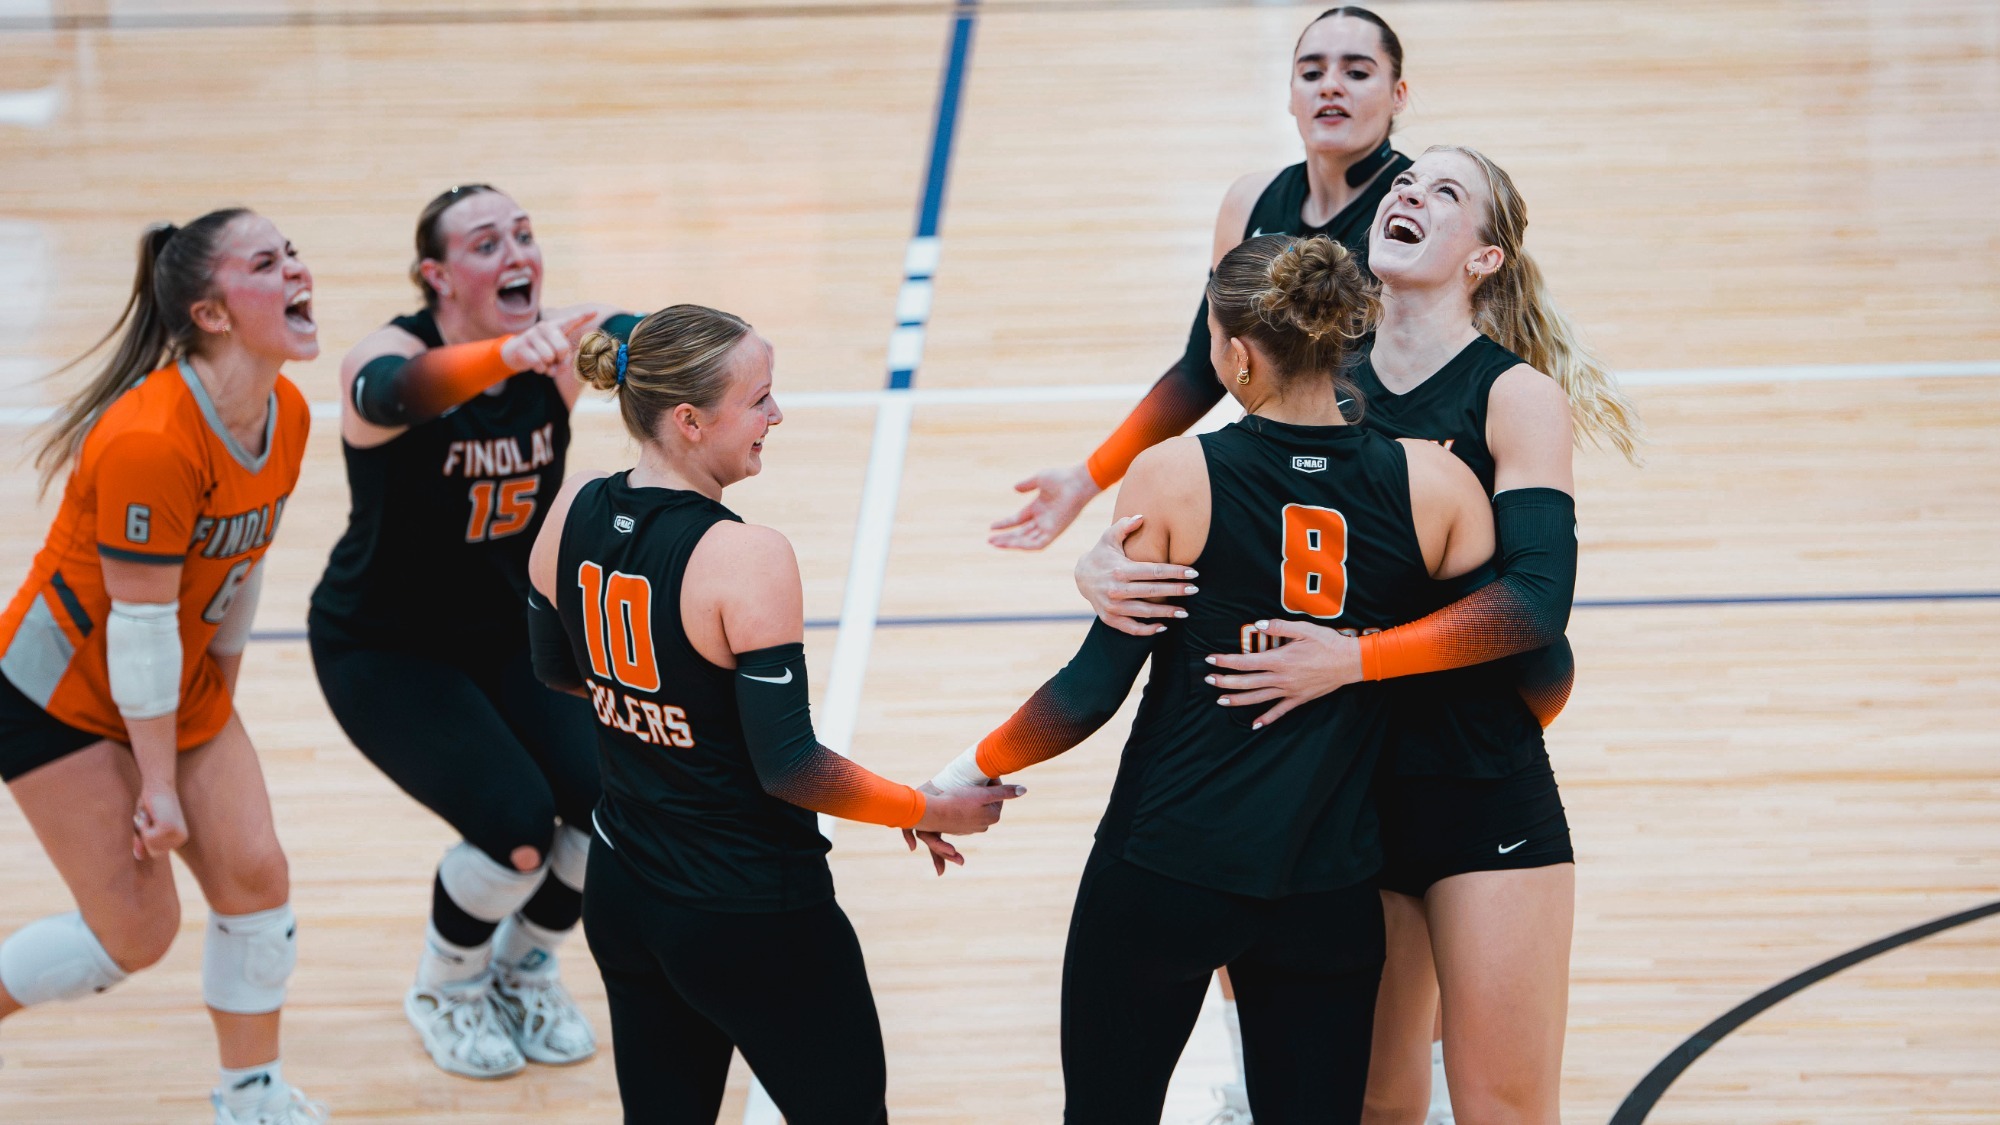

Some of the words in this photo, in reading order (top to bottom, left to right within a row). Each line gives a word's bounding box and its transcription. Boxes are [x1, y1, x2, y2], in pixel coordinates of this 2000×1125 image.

[126, 502, 151, 544] 6
[465, 474, 541, 543] 15
[1281, 503, 1348, 619] 8
[578, 560, 661, 693] 10
[586, 678, 695, 748] OILERS
